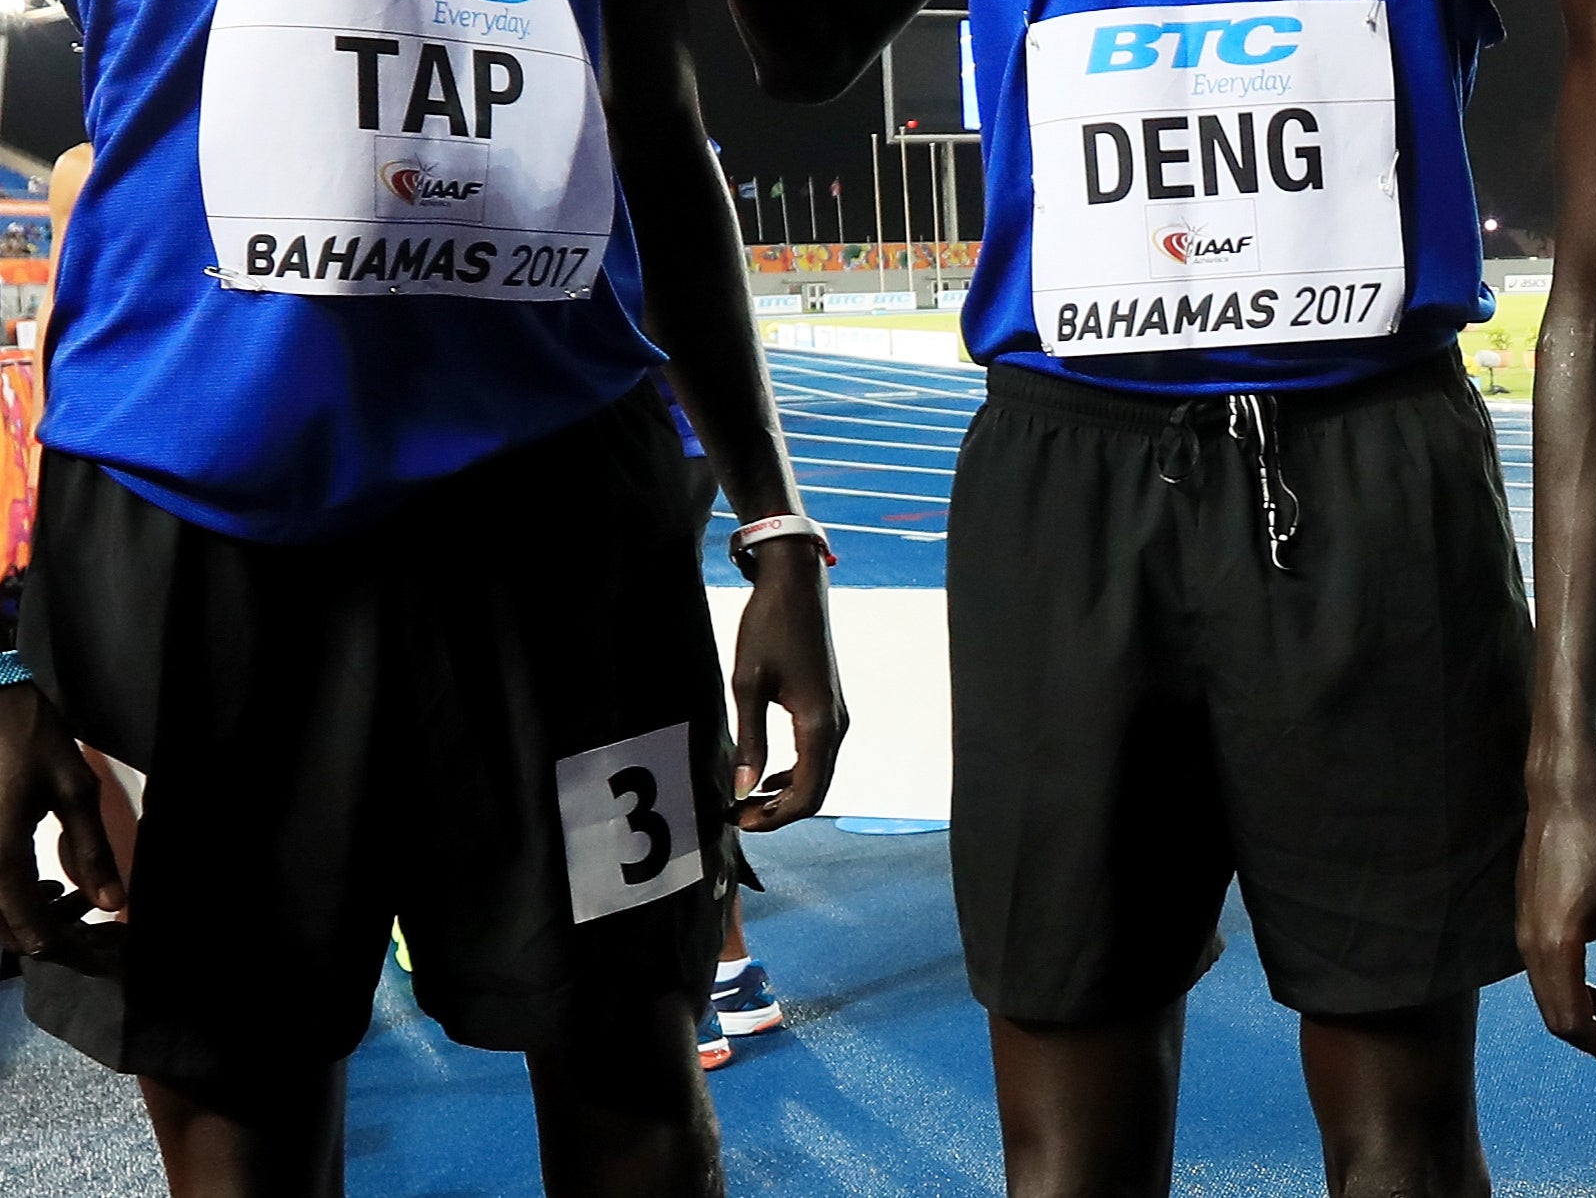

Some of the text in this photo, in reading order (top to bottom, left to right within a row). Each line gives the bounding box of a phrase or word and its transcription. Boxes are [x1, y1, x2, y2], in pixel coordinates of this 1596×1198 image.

[1085, 15, 1304, 76] BTC
[334, 35, 525, 140] TAP
[1081, 107, 1324, 206] DENG
[421, 179, 484, 201] IAAF
[246, 233, 590, 288] BAHAMAS 2017
[1194, 235, 1254, 257] IAAF
[1057, 282, 1382, 343] BAHAMAS 2017
[607, 764, 672, 886] 3
